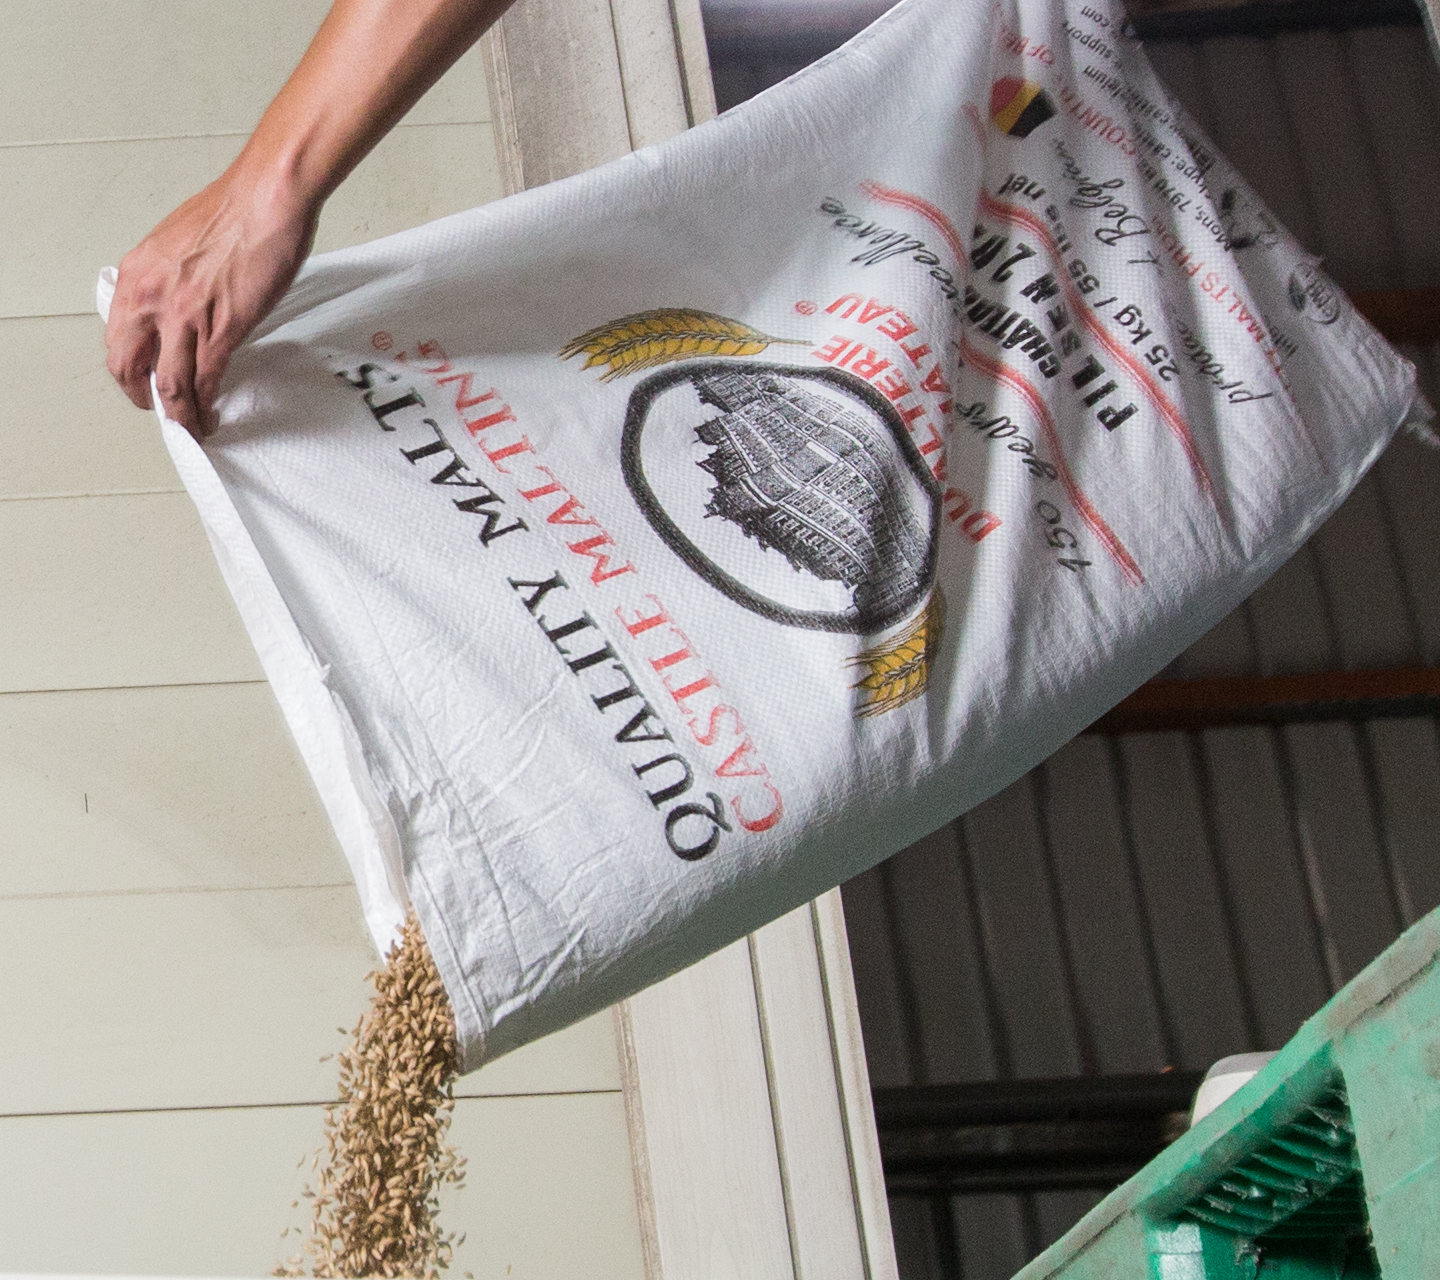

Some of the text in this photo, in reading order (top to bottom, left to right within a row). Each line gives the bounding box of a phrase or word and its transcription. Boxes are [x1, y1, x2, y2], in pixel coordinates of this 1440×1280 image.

[1068, 258, 1100, 294] 55
[1113, 304, 1152, 345] kg
[1021, 273, 1139, 432] PILSEN
[1145, 344, 1180, 382] 25
[334, 362, 732, 862] QUALITY MALTS
[615, 593, 784, 833] CASTLE
